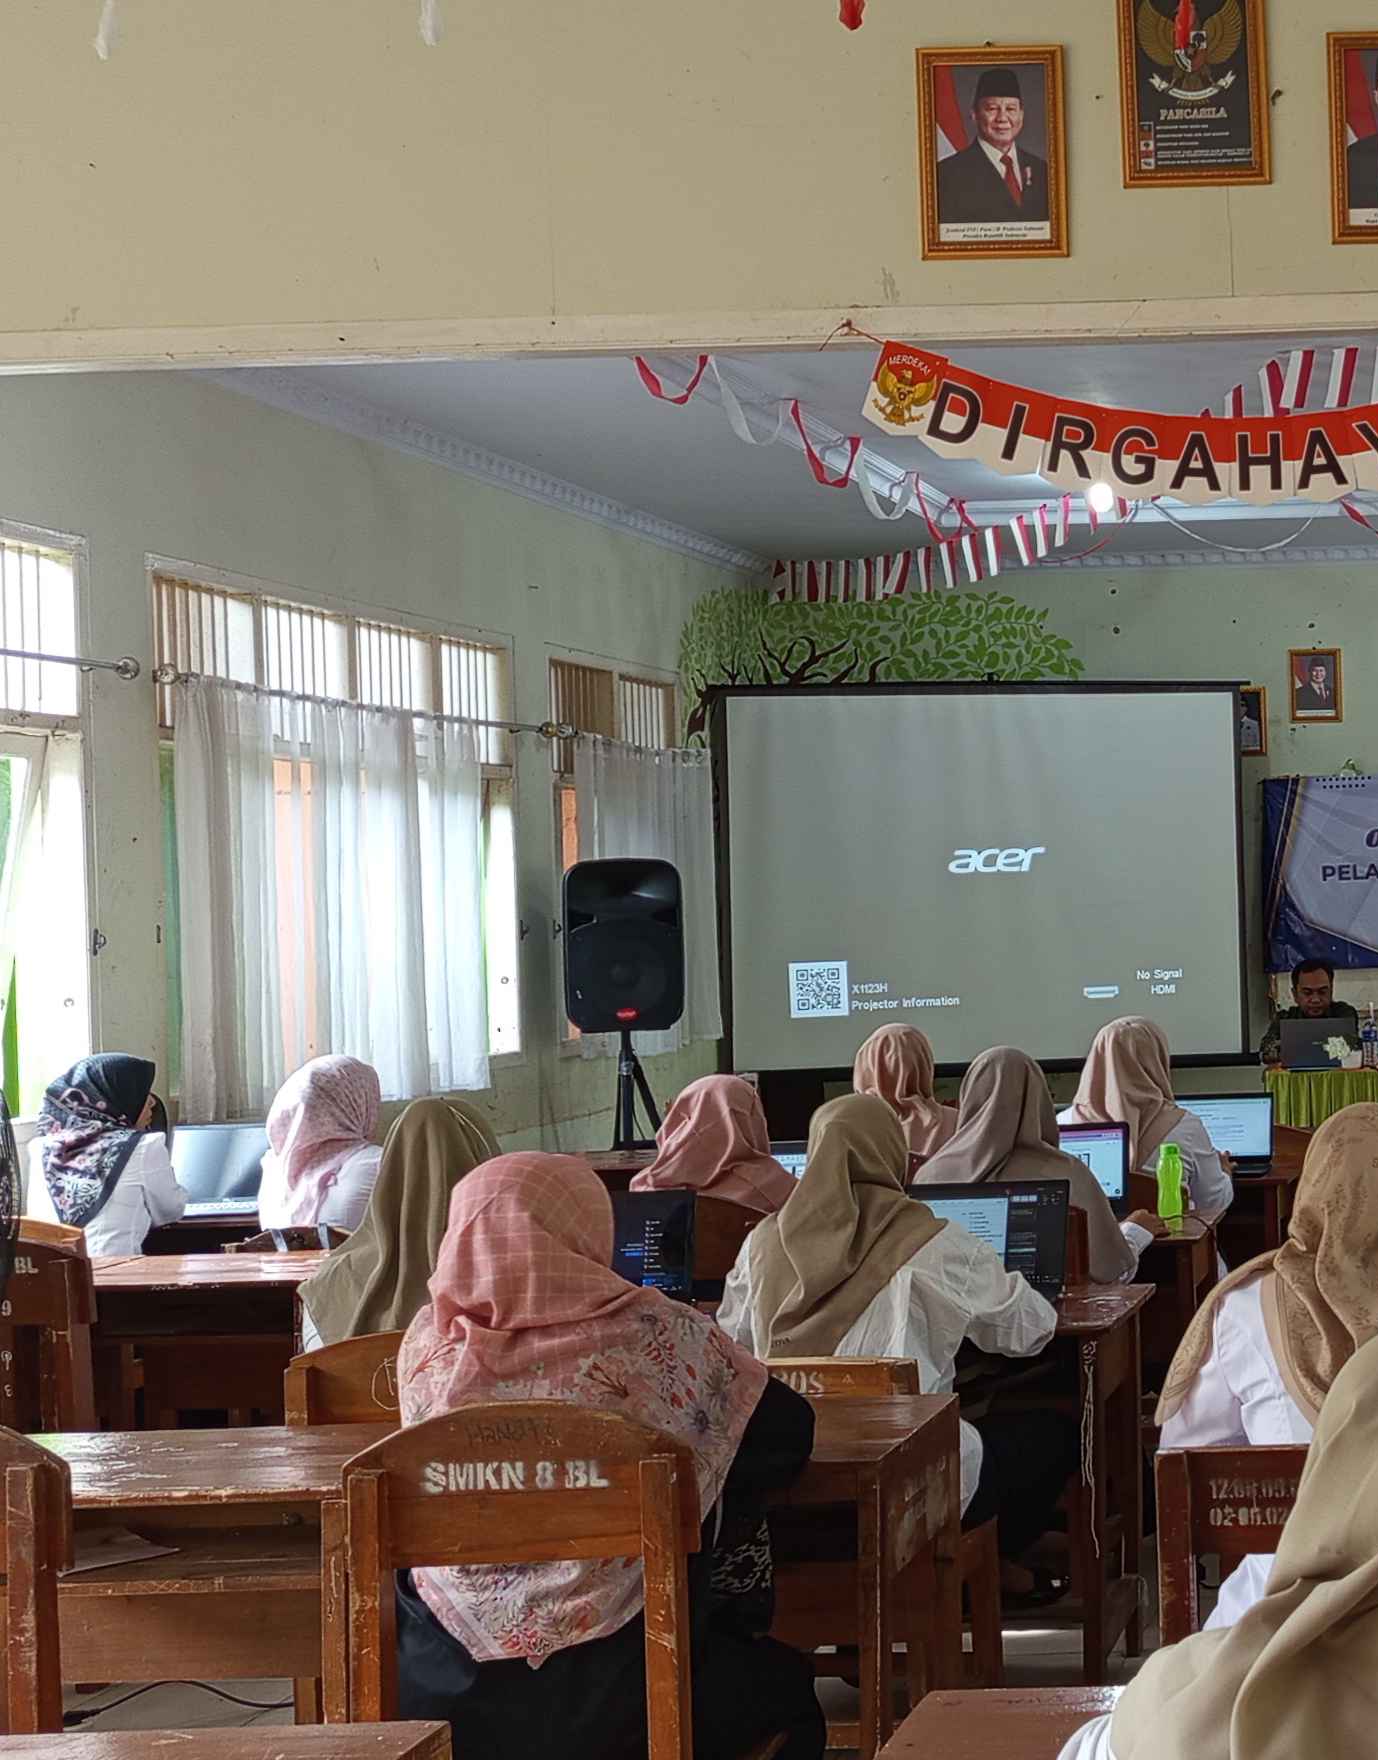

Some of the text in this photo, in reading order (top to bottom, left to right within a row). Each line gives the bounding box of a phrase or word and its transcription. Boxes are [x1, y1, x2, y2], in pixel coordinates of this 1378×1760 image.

[1160, 107, 1228, 120] PANCASILA
[947, 846, 1046, 873] acer
[1136, 968, 1183, 981] No Signal
[851, 982, 888, 995] X1123H
[1151, 984, 1176, 994] HDMI
[851, 996, 960, 1011] Projector Information
[14, 1256, 39, 1275] BL
[423, 1459, 609, 1493] SMKN 8 BL
